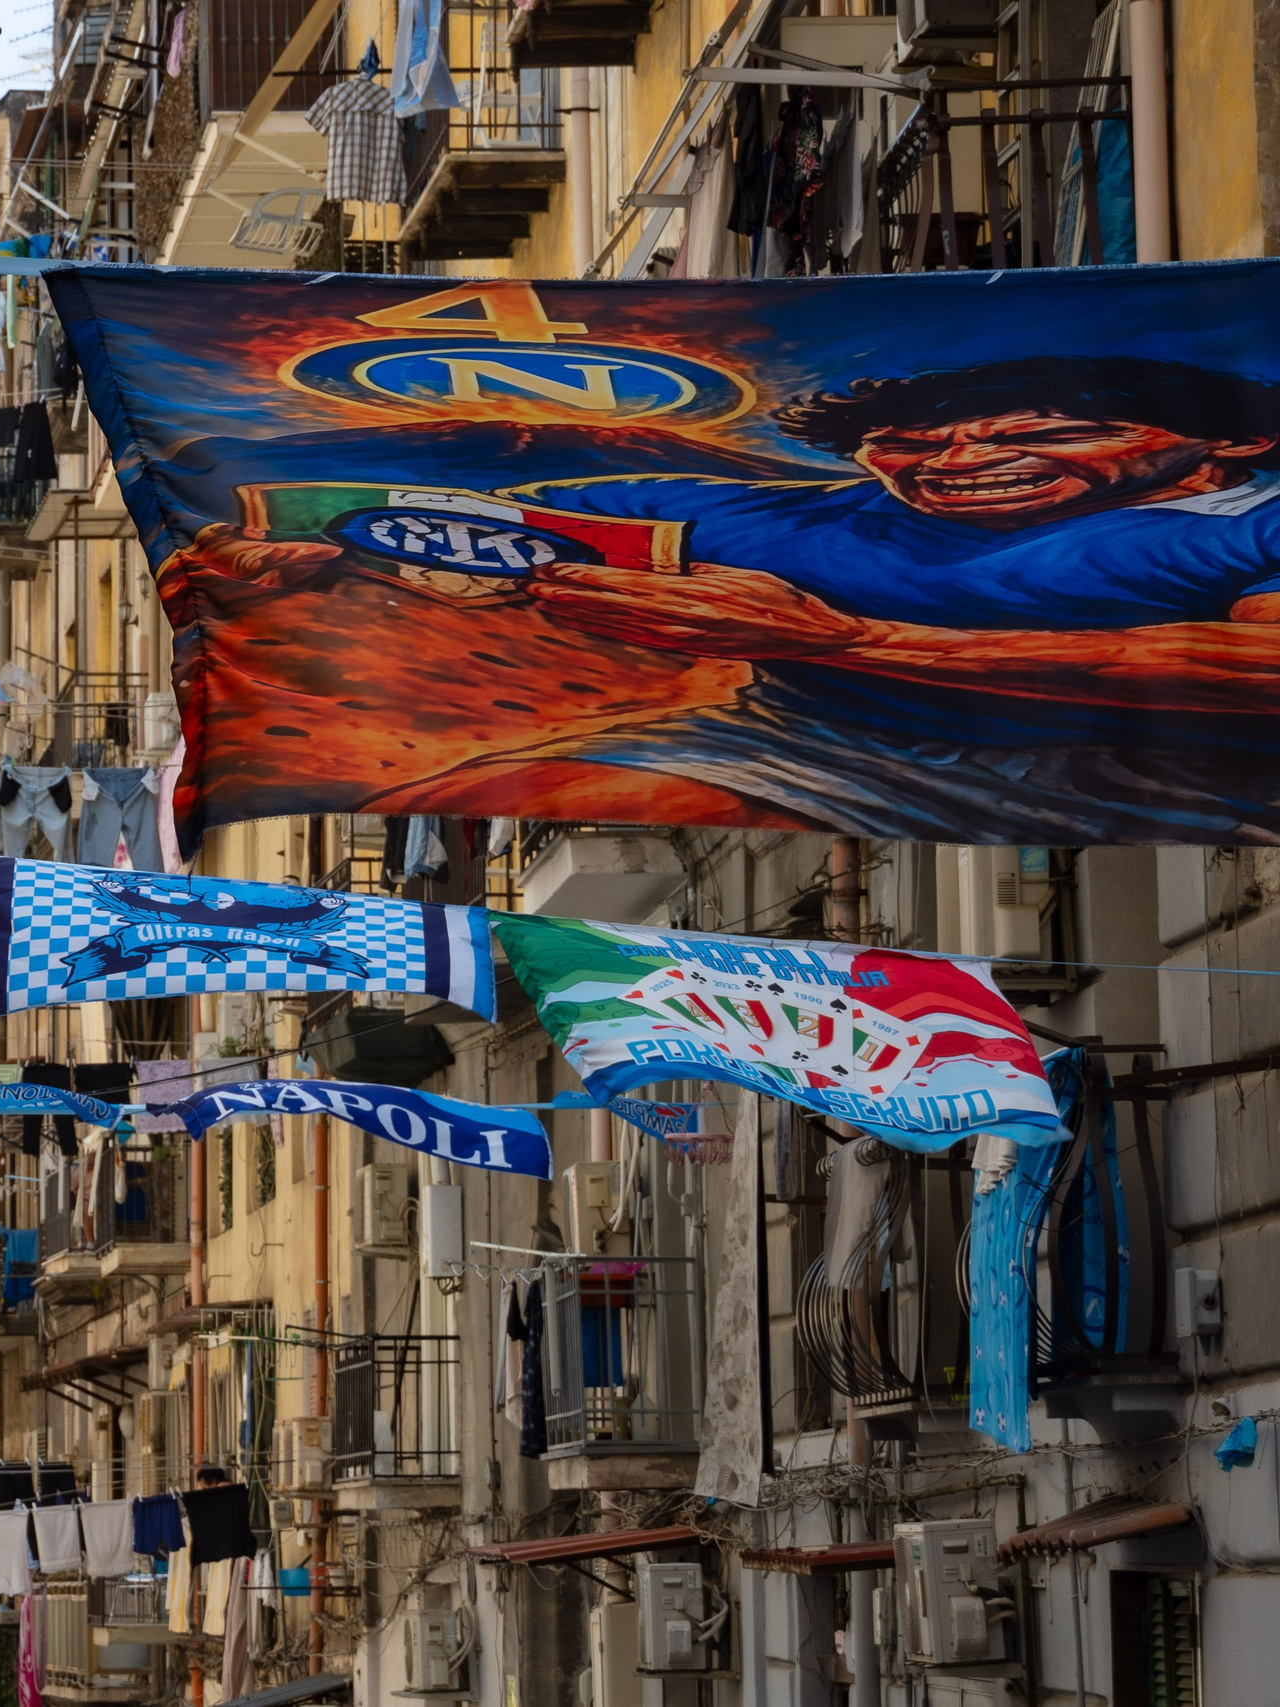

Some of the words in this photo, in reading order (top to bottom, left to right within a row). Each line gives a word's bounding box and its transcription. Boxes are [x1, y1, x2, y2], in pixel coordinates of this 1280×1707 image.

[355, 281, 589, 343] 4
[428, 356, 625, 410] N
[136, 923, 214, 943] Ultras
[658, 936, 830, 970] NAPOLI
[648, 979, 675, 992] 2025
[711, 979, 740, 991] 2023
[769, 963, 891, 988] D'ITALIA
[686, 999, 714, 1022] 4
[793, 991, 823, 1005] 1990
[732, 1003, 761, 1028] 3
[796, 1014, 821, 1039] 2
[871, 1020, 900, 1037] 1987
[625, 1038, 772, 1088] POKER
[856, 1041, 880, 1064] 1
[204, 1084, 512, 1170] NAPOLI
